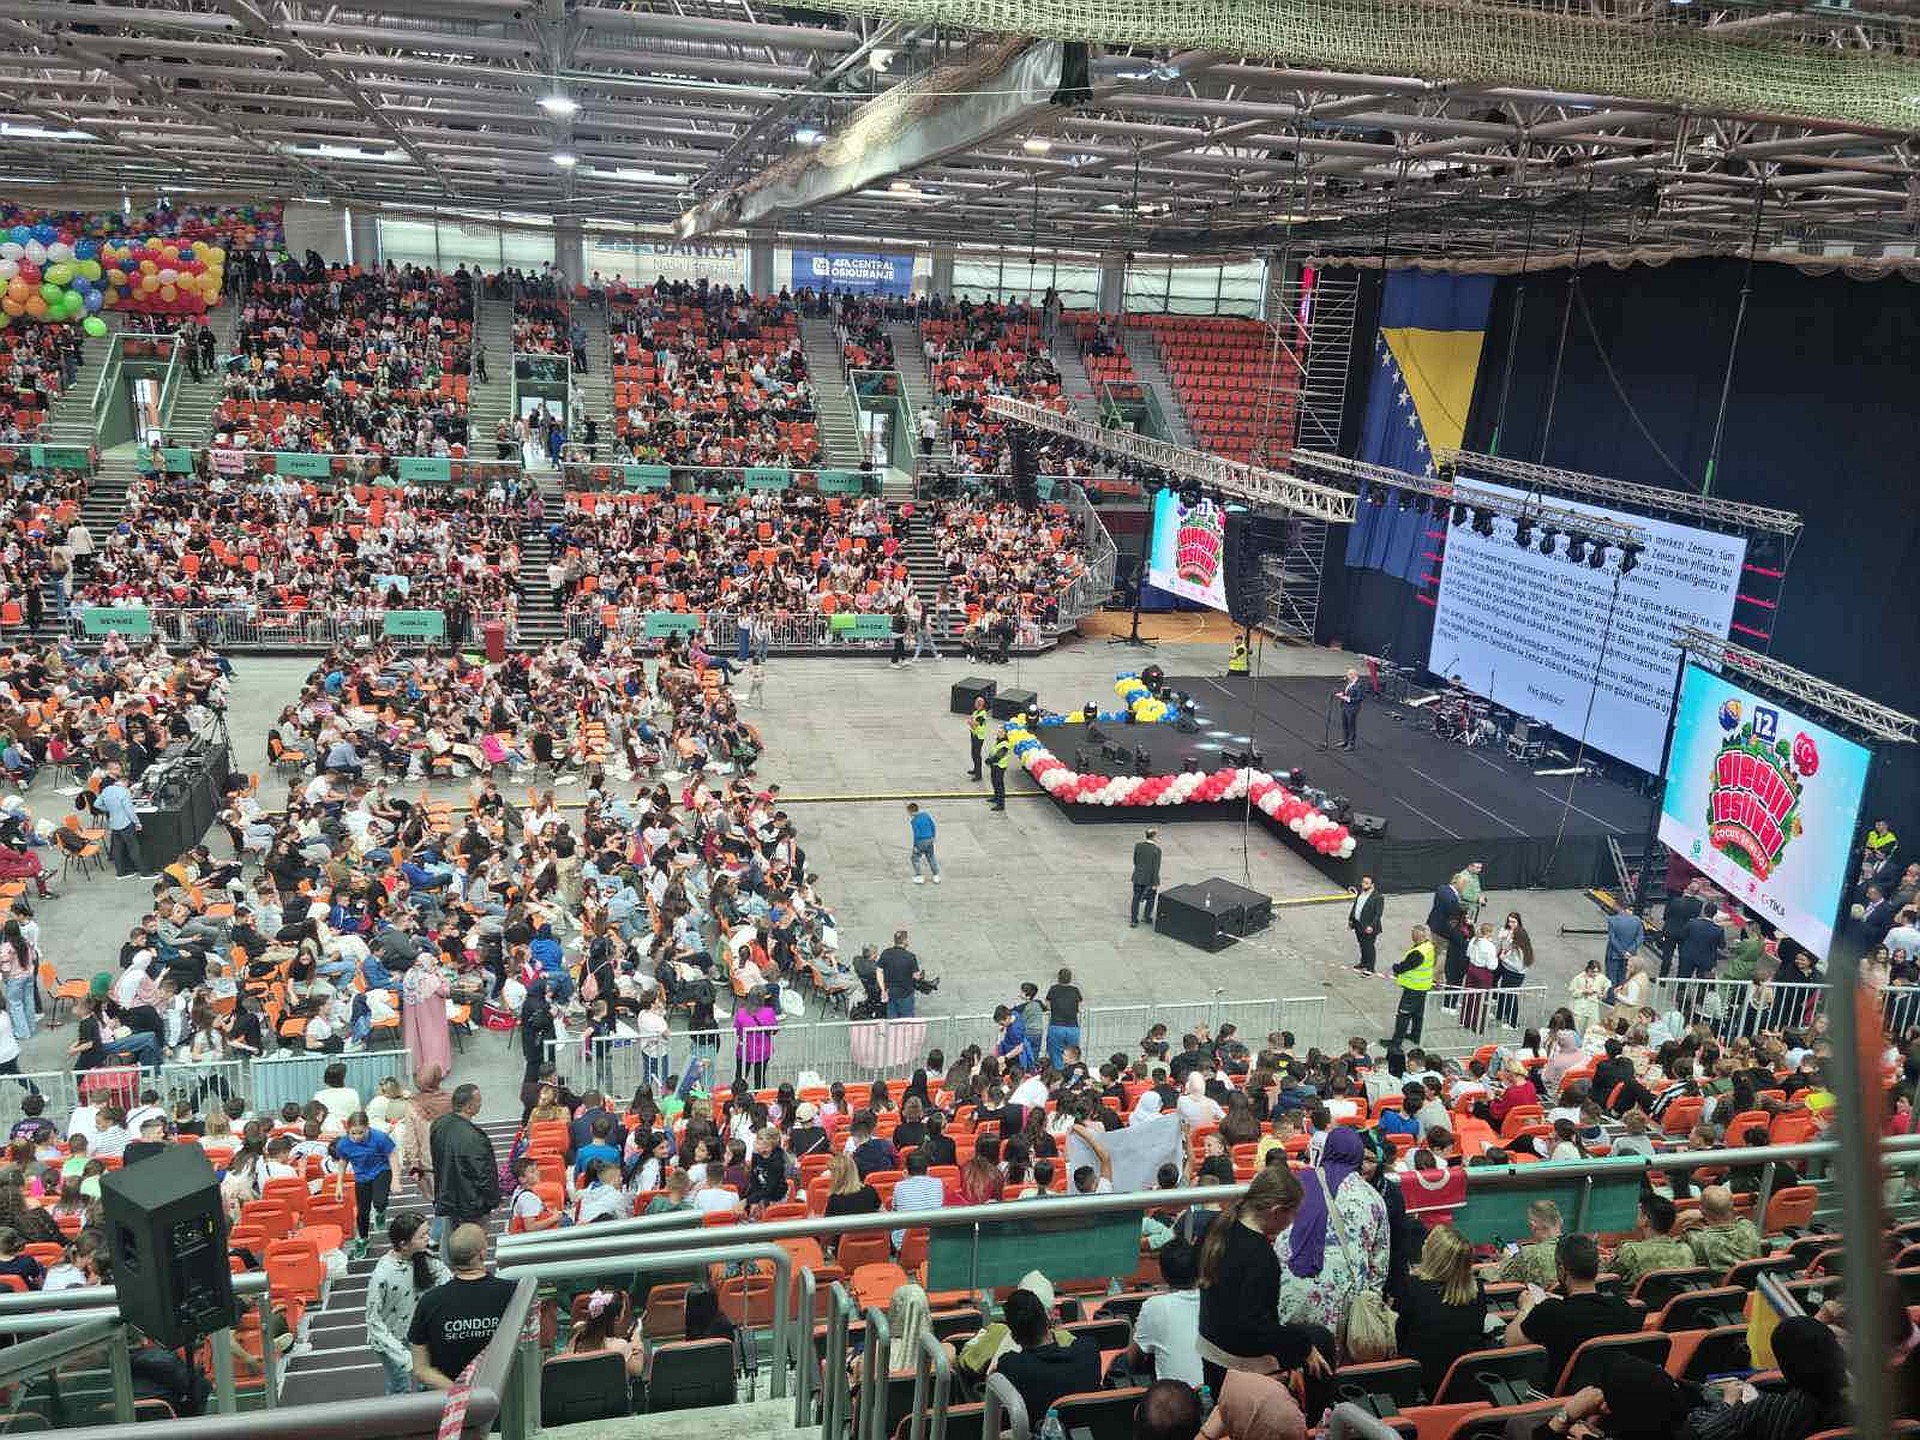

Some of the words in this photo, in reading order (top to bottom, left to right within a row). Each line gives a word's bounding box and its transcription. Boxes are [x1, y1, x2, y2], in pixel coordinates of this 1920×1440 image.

[853, 260, 894, 270] CENTRAL
[443, 1316, 500, 1332] CONDOR
[443, 1329, 495, 1340] SECURIT
